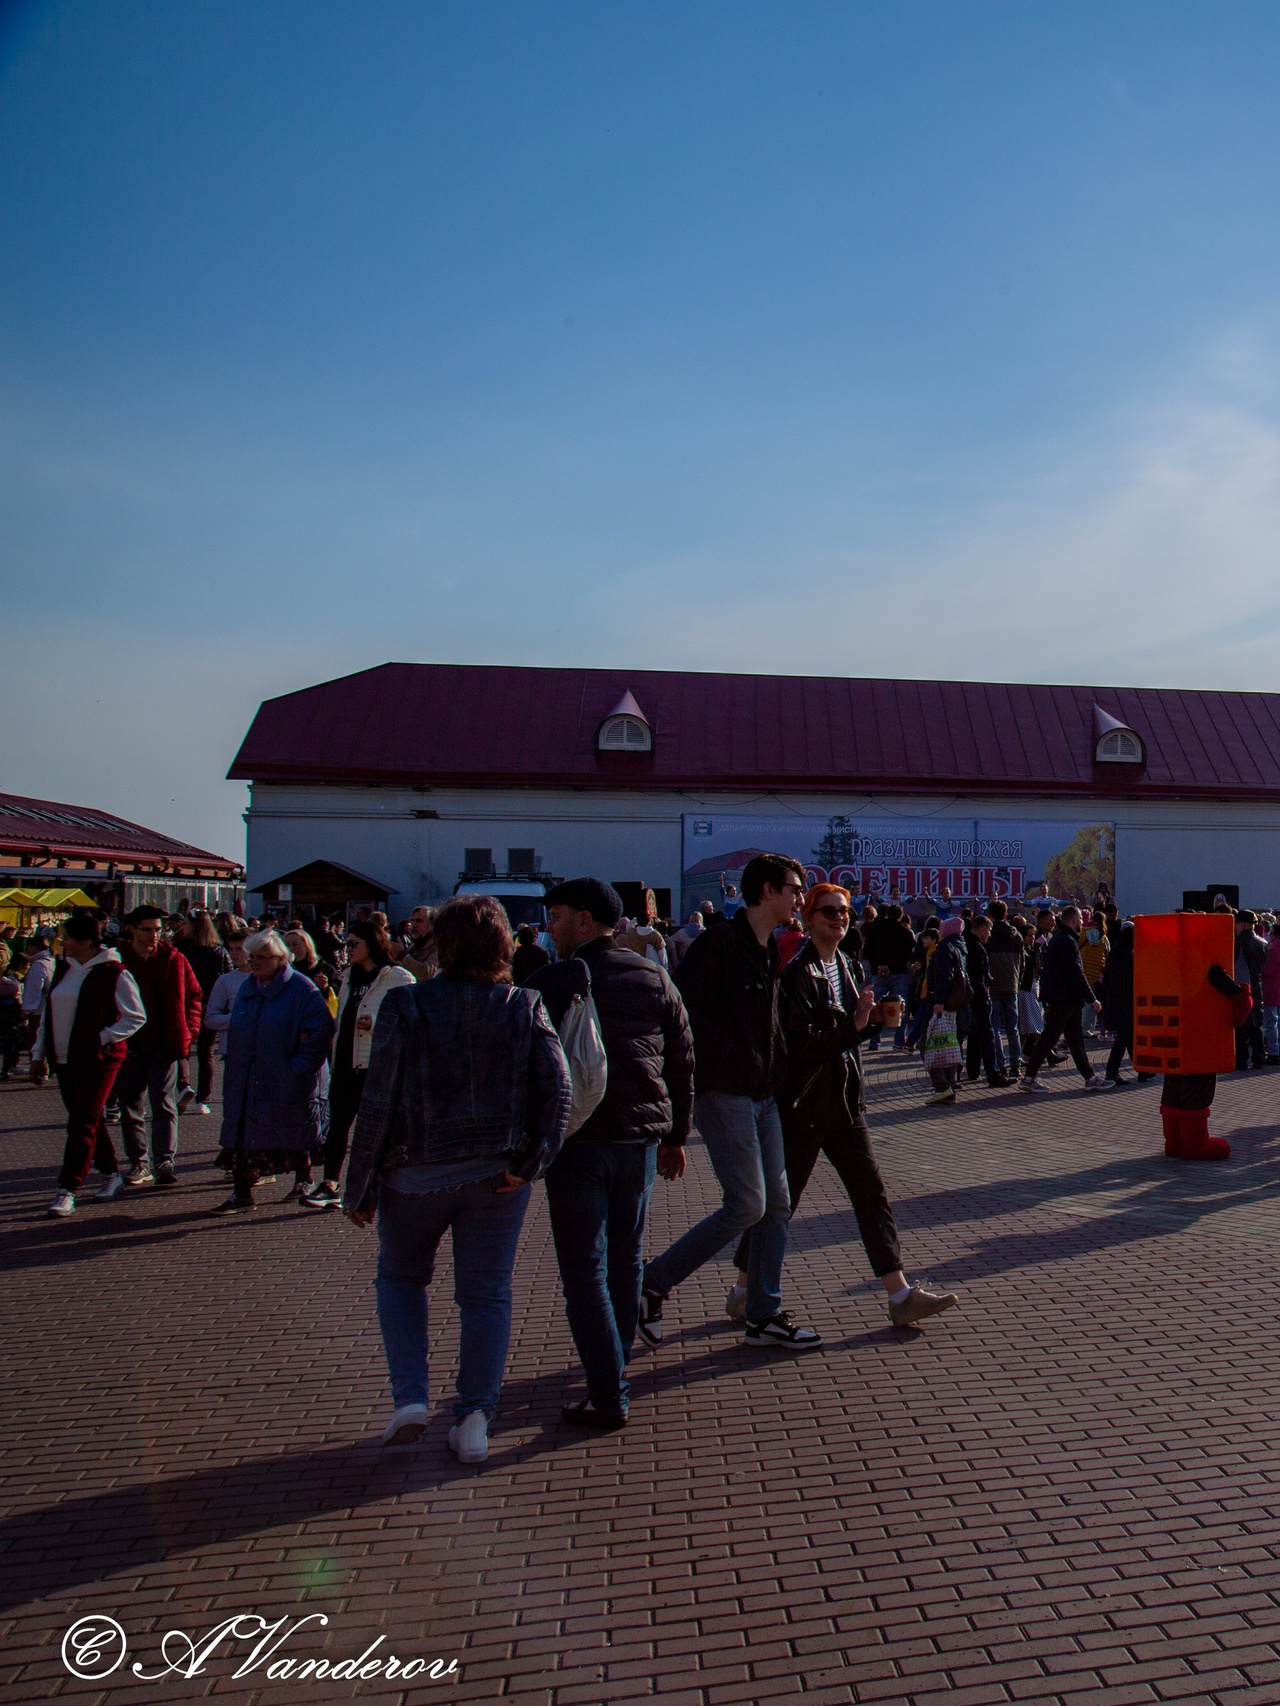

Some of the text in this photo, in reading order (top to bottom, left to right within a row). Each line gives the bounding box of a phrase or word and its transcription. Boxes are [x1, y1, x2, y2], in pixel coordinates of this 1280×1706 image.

[719, 824, 772, 832] ДЕПАРТАМЕНТ
[773, 825, 809, 833] КУЛЬТУРЫ
[911, 827, 939, 835] ОМСКА
[850, 838, 1023, 864] праздник урожая
[934, 1036, 949, 1046] FIX
